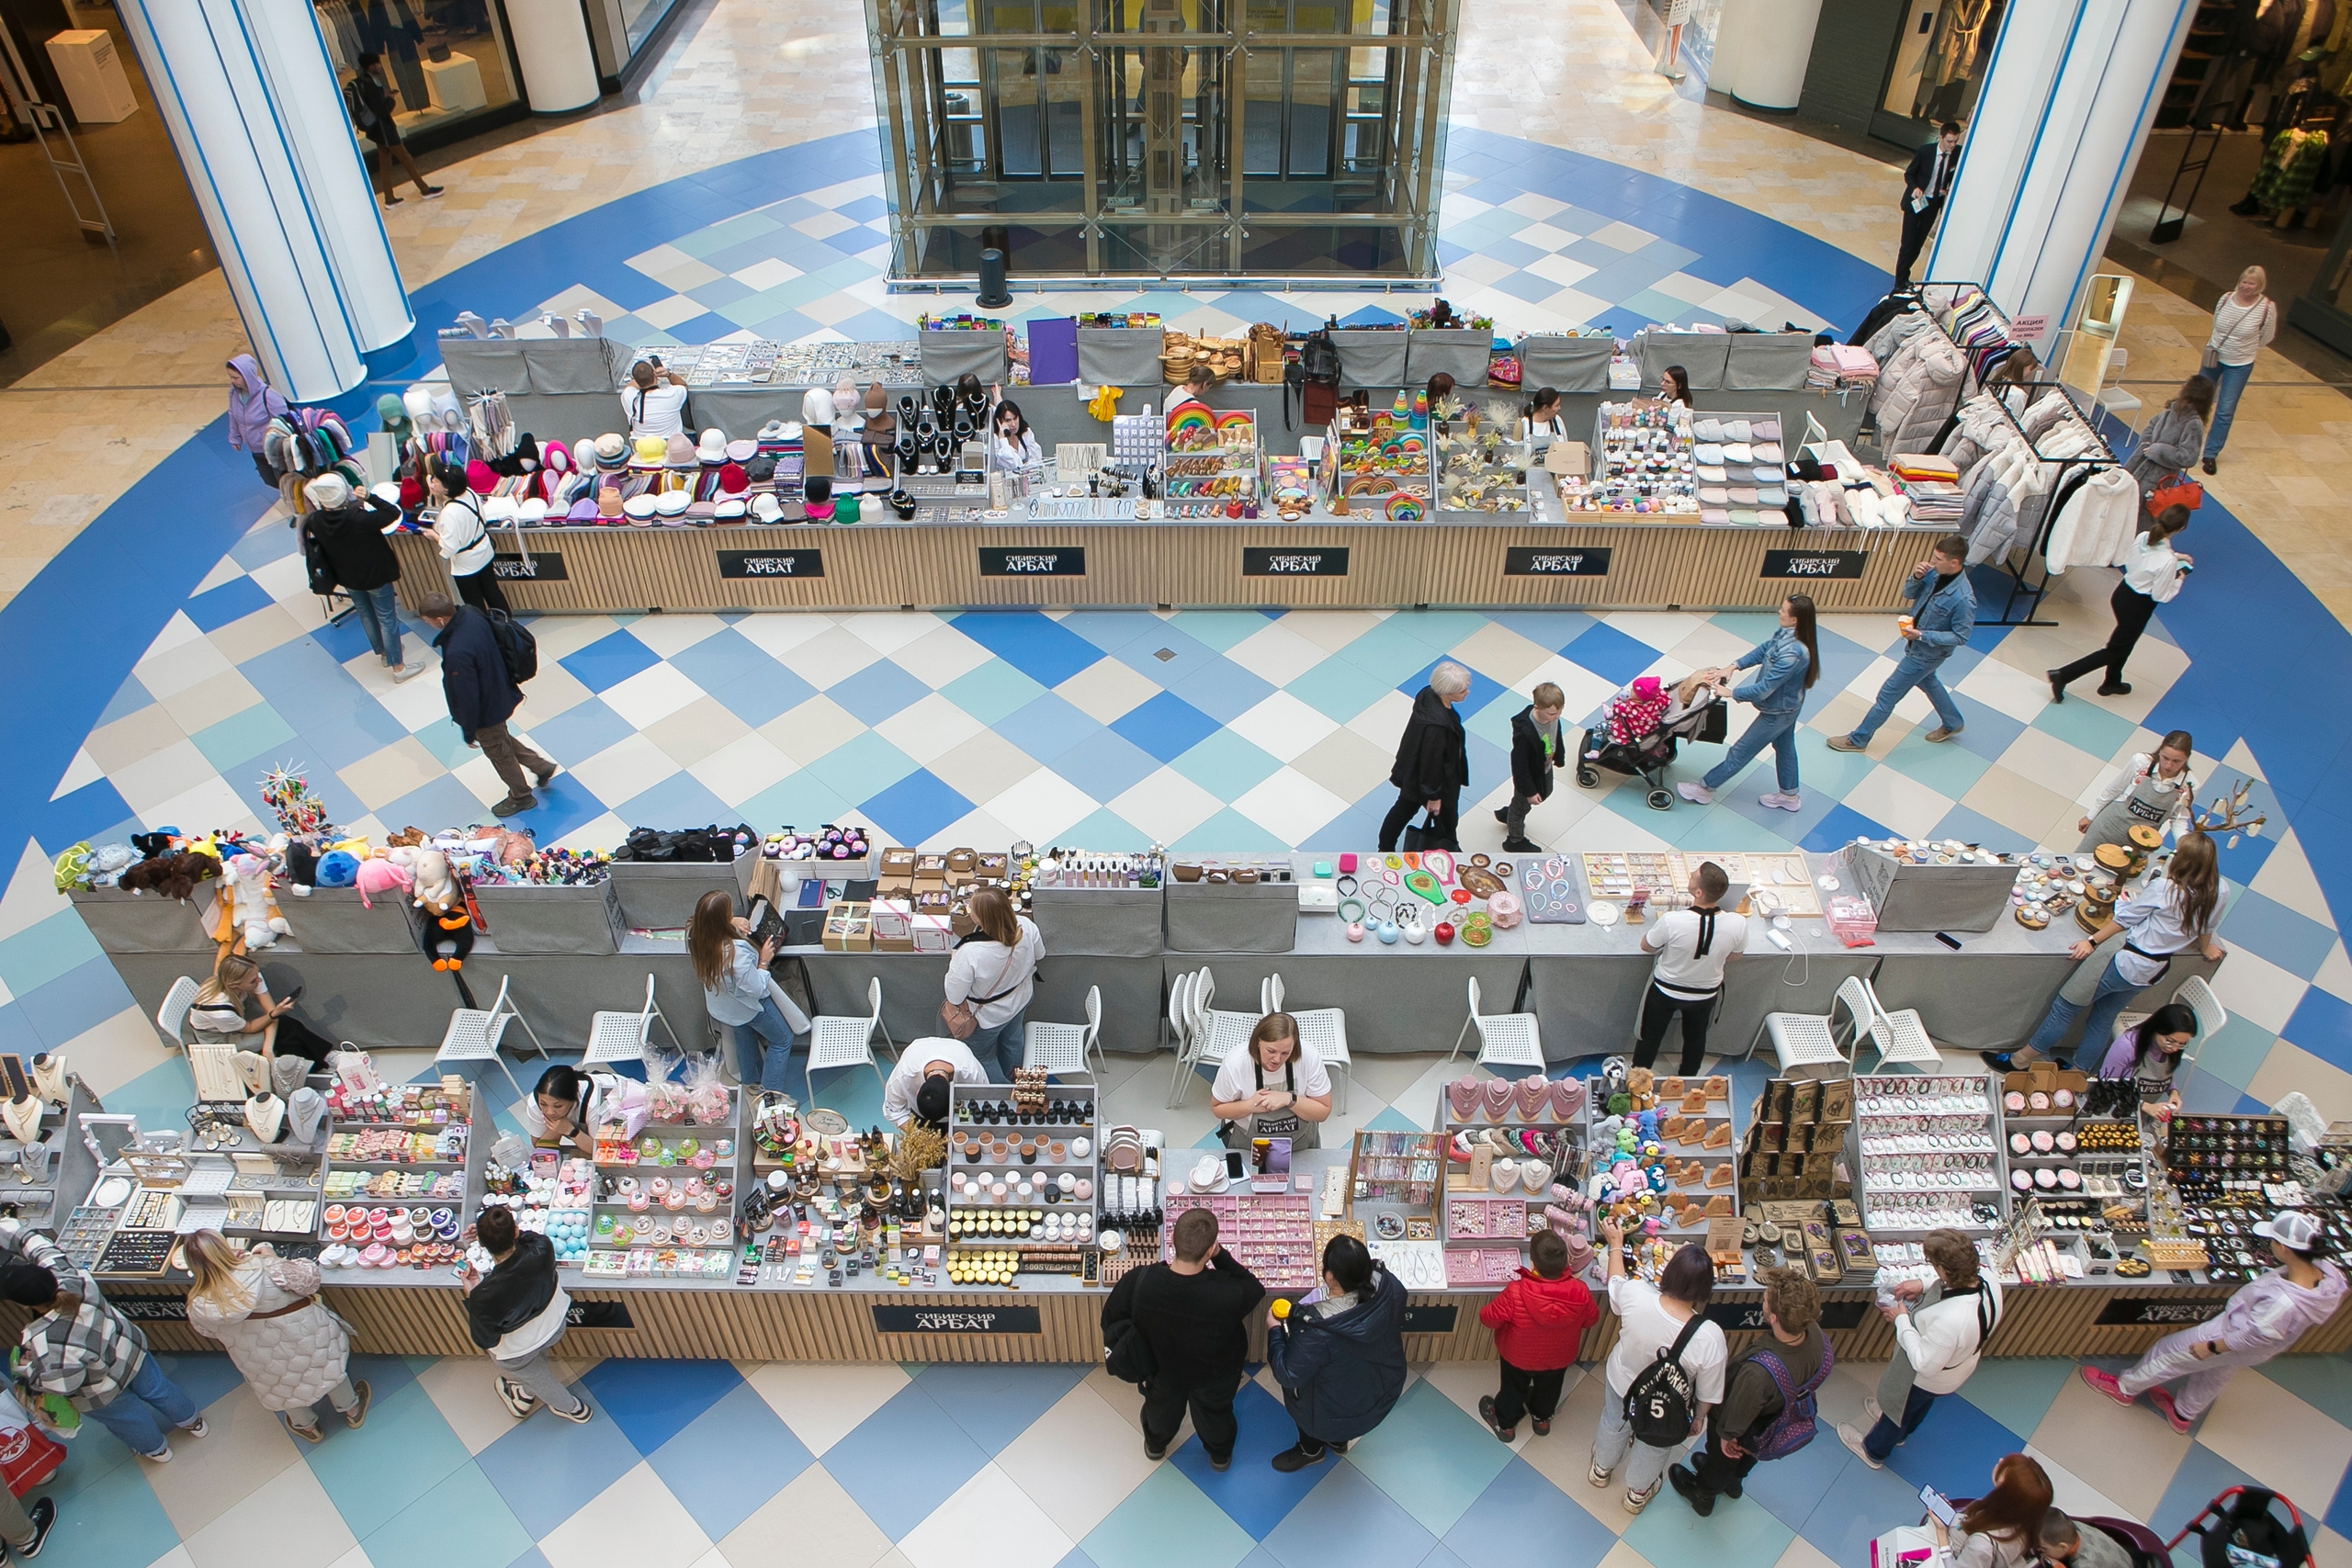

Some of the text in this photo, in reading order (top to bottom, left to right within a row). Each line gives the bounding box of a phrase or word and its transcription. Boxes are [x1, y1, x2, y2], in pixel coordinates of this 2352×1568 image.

[743, 556, 795, 564] СИБИРСКИЙ
[1006, 554, 1057, 562] СИБИРСКИЙ
[1269, 554, 1321, 562] СИБИРСКИЙ
[1532, 554, 1583, 563] СИБИРСКИЙ
[1790, 557, 1840, 565] СИБИРСКИЙ
[746, 562, 794, 574] АРБАТ
[1006, 560, 1056, 571] АРБАТ
[1269, 560, 1318, 571] АРБАТ
[1530, 560, 1578, 571] АРБАТ
[1786, 563, 1837, 574] АРБАТ
[2130, 805, 2161, 820] АРБАТ
[1259, 1116, 1297, 1126] СИБИРСКИЙ
[1260, 1123, 1297, 1134] АРБАТ
[117, 1306, 187, 1317] АРБАТ
[915, 1312, 996, 1320] СИБИРСКИЙ
[2136, 1310, 2218, 1322] АРБАТ
[917, 1318, 994, 1329] АРБАТ
[1650, 1398, 1665, 1418] 5
